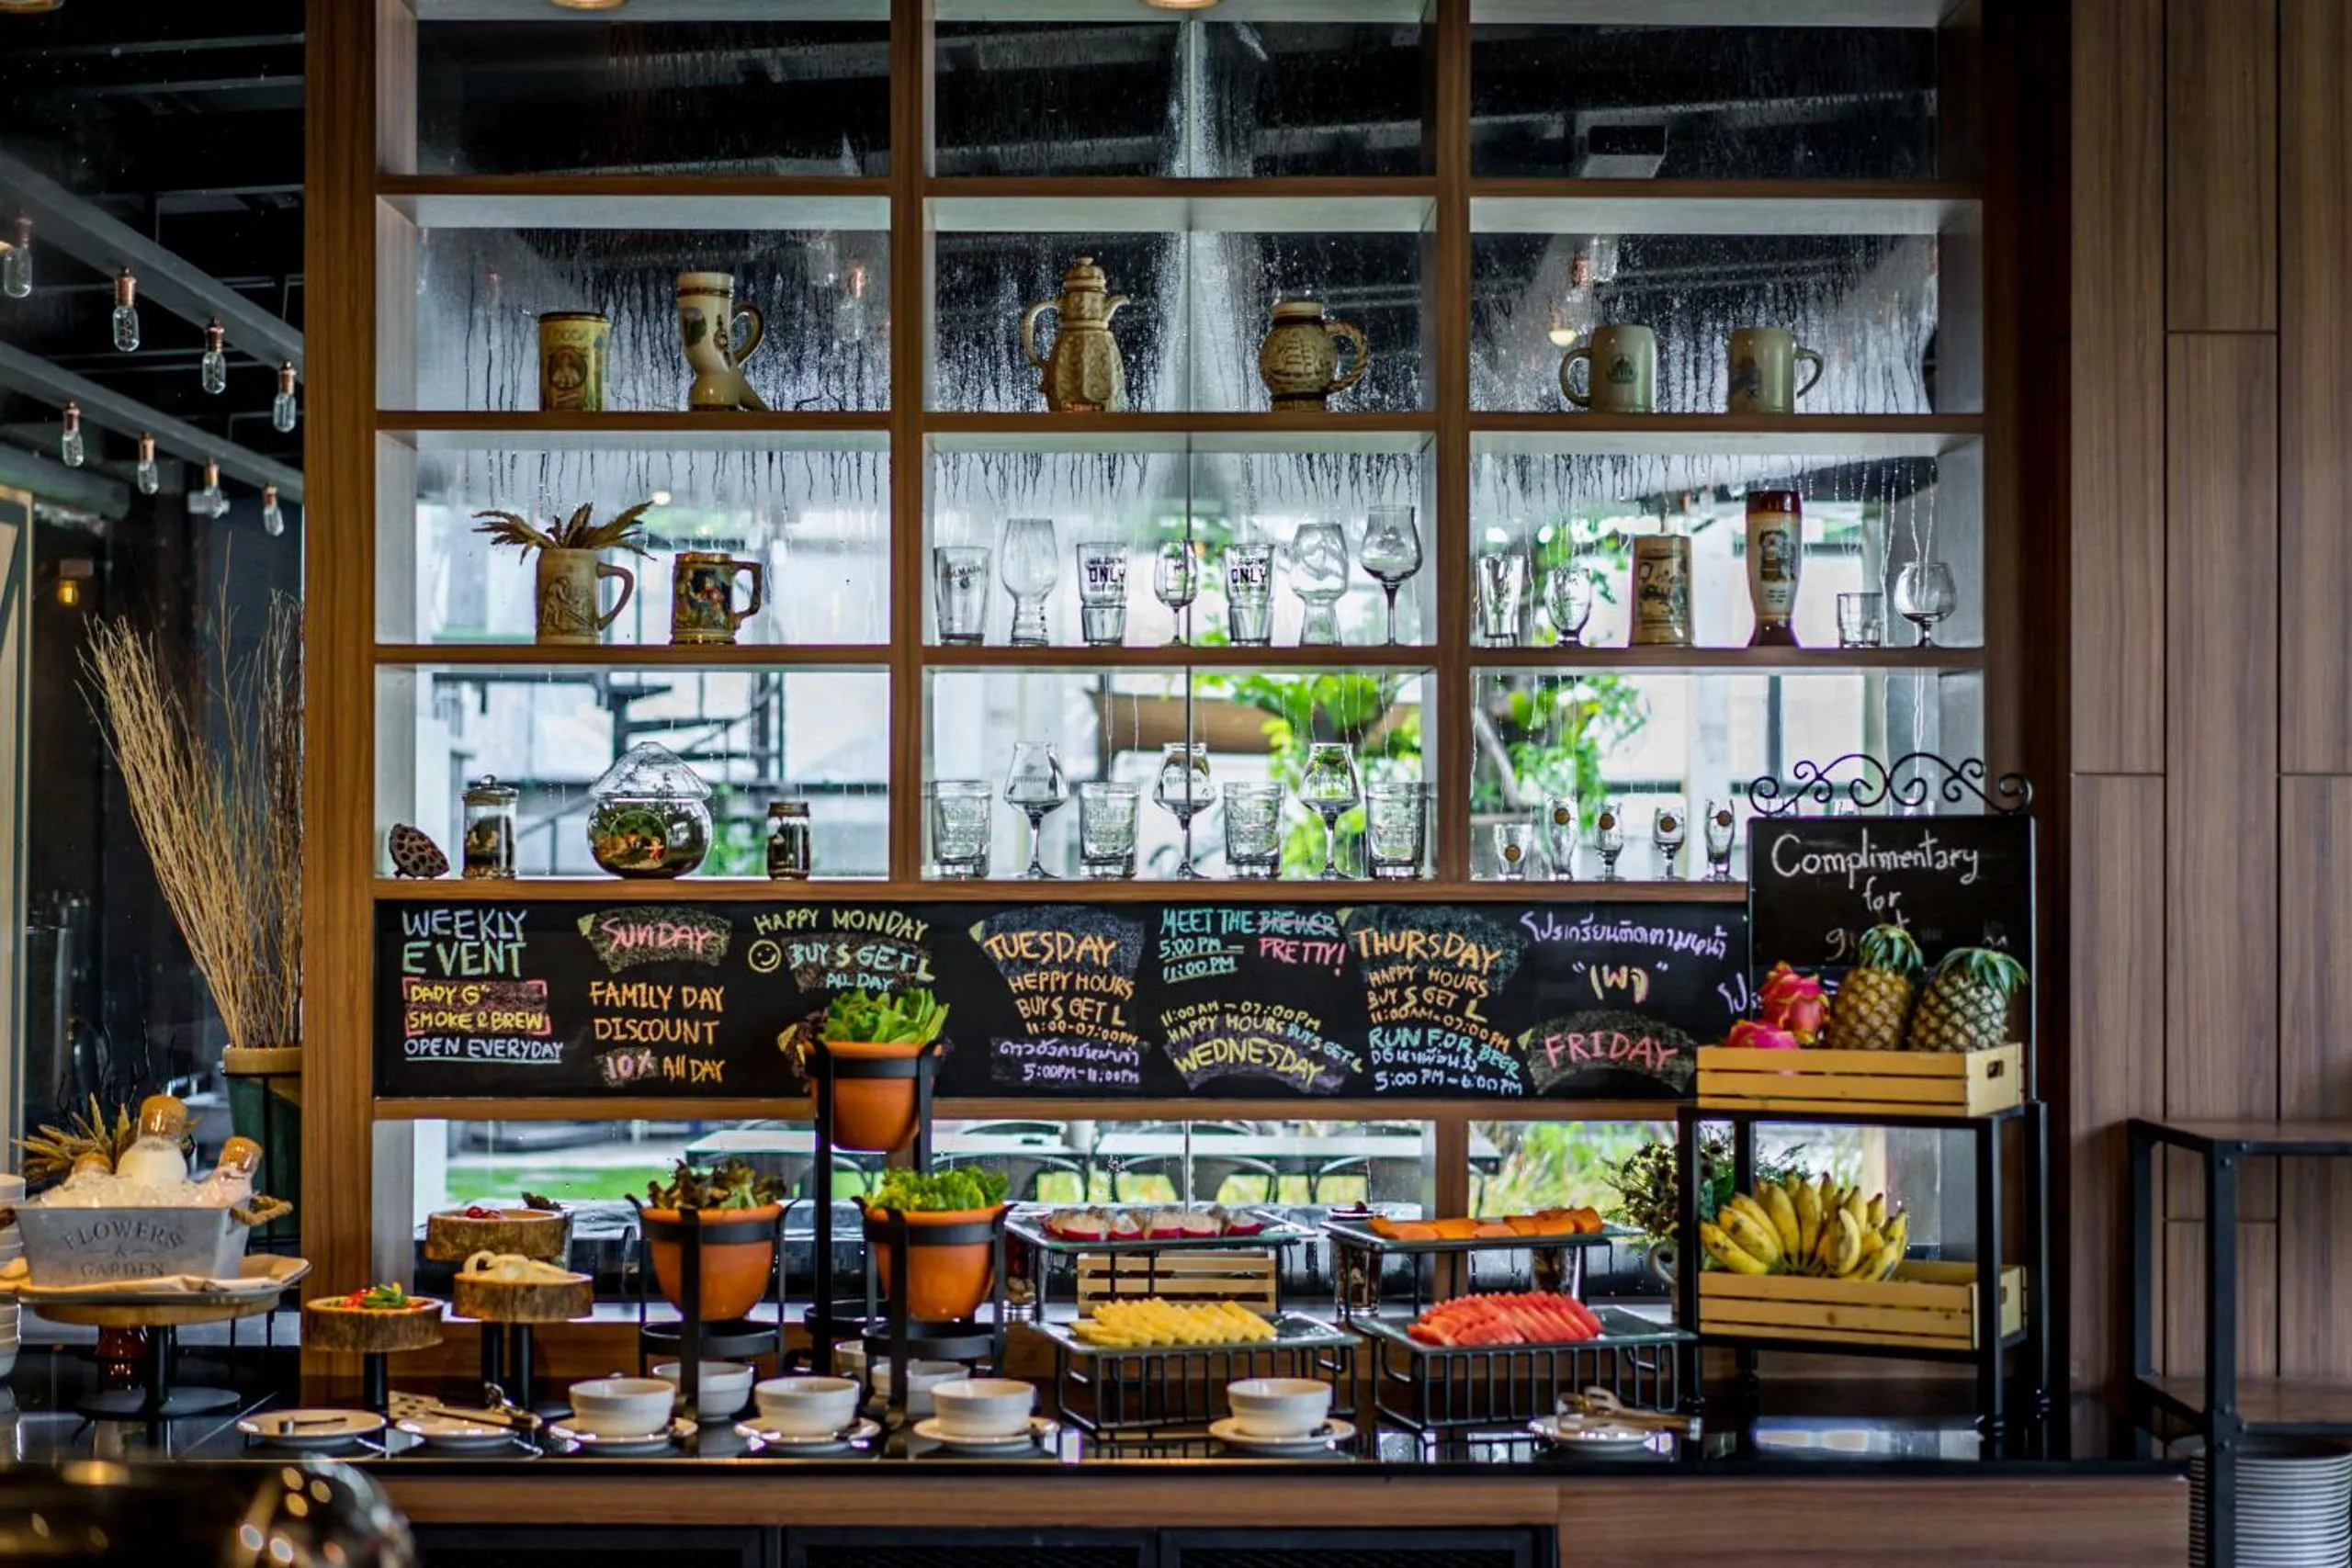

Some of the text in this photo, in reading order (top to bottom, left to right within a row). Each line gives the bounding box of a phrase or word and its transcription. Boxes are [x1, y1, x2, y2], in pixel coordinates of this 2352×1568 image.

[1089, 566, 1126, 583] ONLY
[1231, 568, 1267, 584] ONLY
[1771, 828, 1979, 890] Complimentary
[1861, 875, 1903, 912] for
[402, 908, 527, 942] WEEKLY
[753, 908, 929, 942] HAPPY MONDAY
[1159, 908, 1214, 938] MEET
[1216, 908, 1257, 934] THE
[402, 941, 527, 977] EVENT
[788, 942, 830, 970] BUY
[856, 944, 917, 971] GET
[983, 931, 1117, 967] TUESDAY
[1259, 937, 1346, 977] PRETTY!
[1351, 927, 1502, 976] THURSDAY
[411, 985, 457, 1005] DADY
[589, 981, 725, 1012] FAMILY DAY
[856, 973, 895, 992] DAY
[1007, 971, 1136, 1001] HEPPY HOURS
[1368, 964, 1489, 998] HAPPY HOURS
[1014, 995, 1049, 1019] BUY
[1069, 996, 1108, 1023] GET
[1367, 987, 1398, 1010] BUY
[1422, 986, 1459, 1009] GET
[409, 1011, 473, 1030] SMOKE
[491, 1011, 544, 1031] BREW
[594, 1017, 720, 1045] DISCOUNT
[404, 1037, 564, 1060] OPEN EVERYDAY
[1167, 1014, 1218, 1043] HAPPY
[1226, 1013, 1285, 1034] HOURS
[1323, 1041, 1356, 1063] GET
[1368, 1026, 1421, 1050] RUN
[1476, 1043, 1521, 1079] BEER
[1544, 1029, 1679, 1071] FRIDAY
[689, 1059, 726, 1083] DAY
[1172, 1036, 1326, 1088] WEDNESDAY
[62, 1220, 186, 1251] FLOWERS
[80, 1260, 165, 1278] GARDEN
